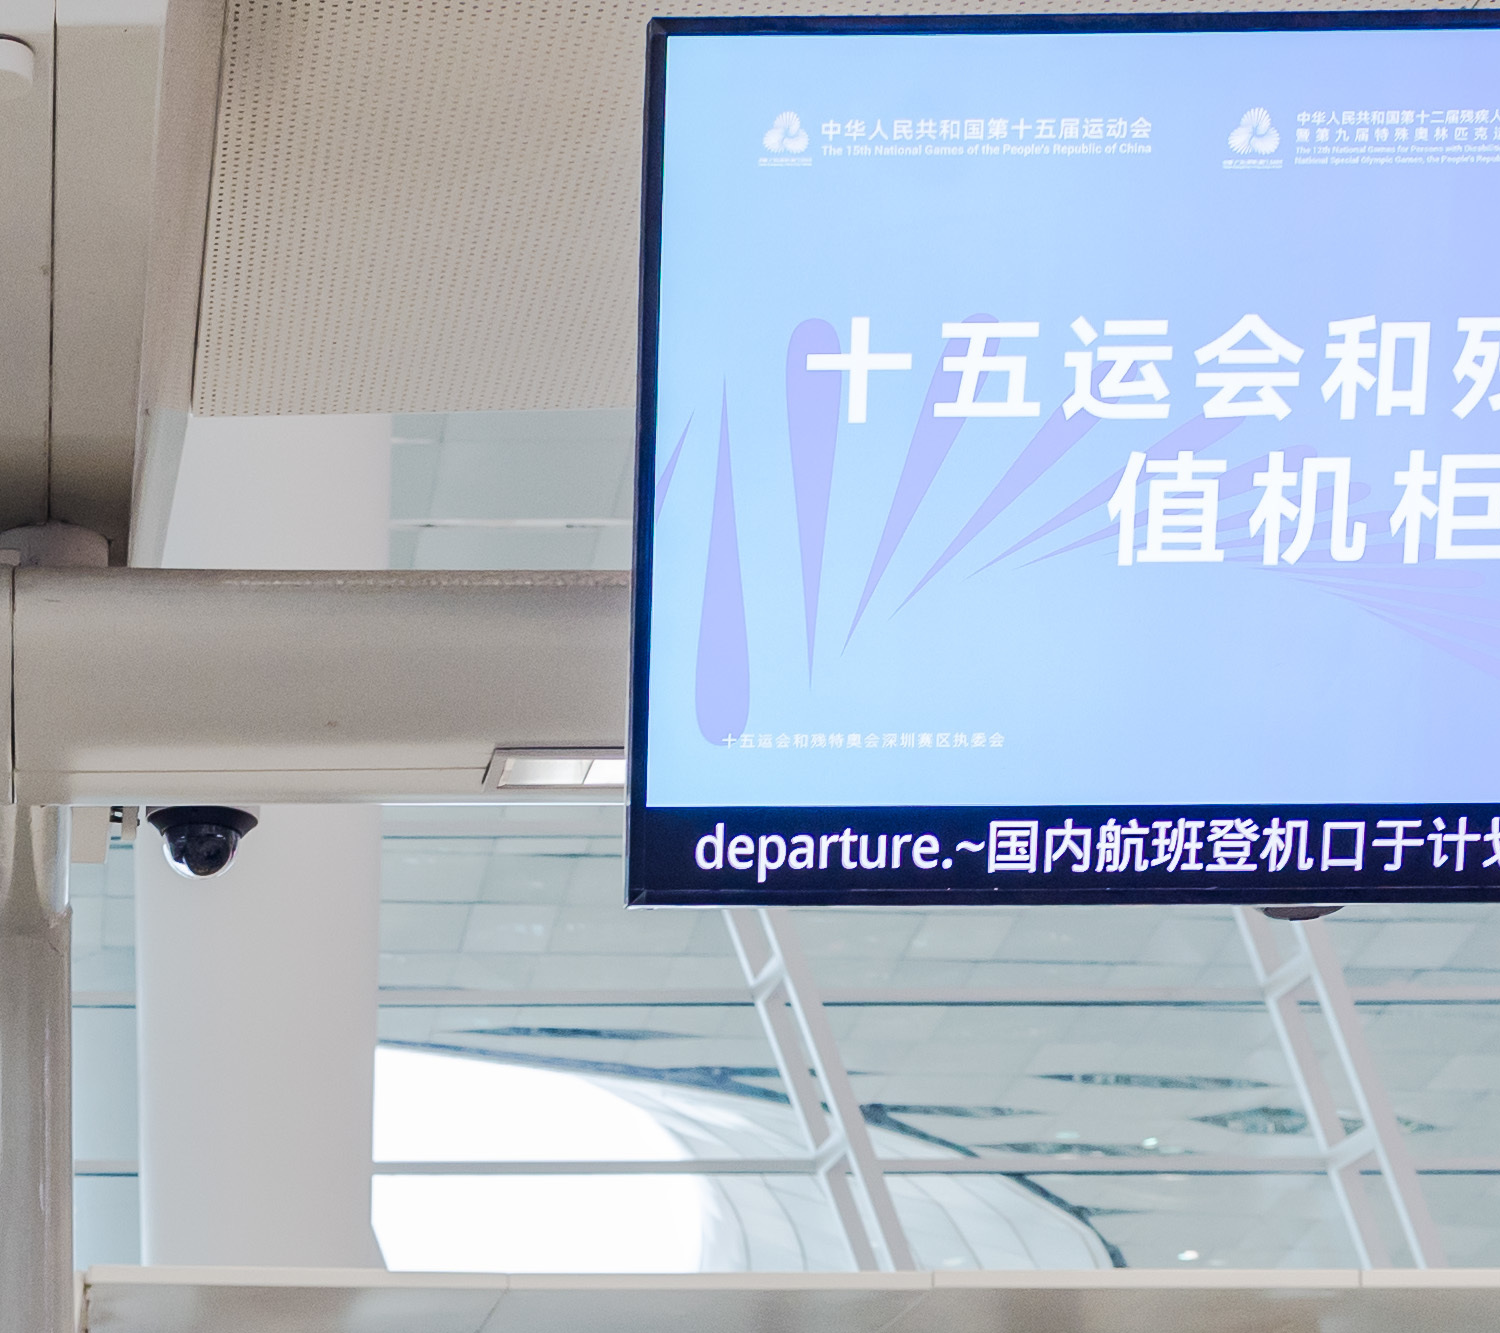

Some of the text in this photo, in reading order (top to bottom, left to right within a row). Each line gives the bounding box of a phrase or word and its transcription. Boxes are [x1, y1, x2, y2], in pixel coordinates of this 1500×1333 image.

[822, 117, 1151, 141] 中华人民共和国第十五届运动会
[821, 142, 1152, 157] The 15th National Games of the People's Republic of China
[722, 732, 1004, 748] 十五运会和残特奥会深圳赛区执委会
